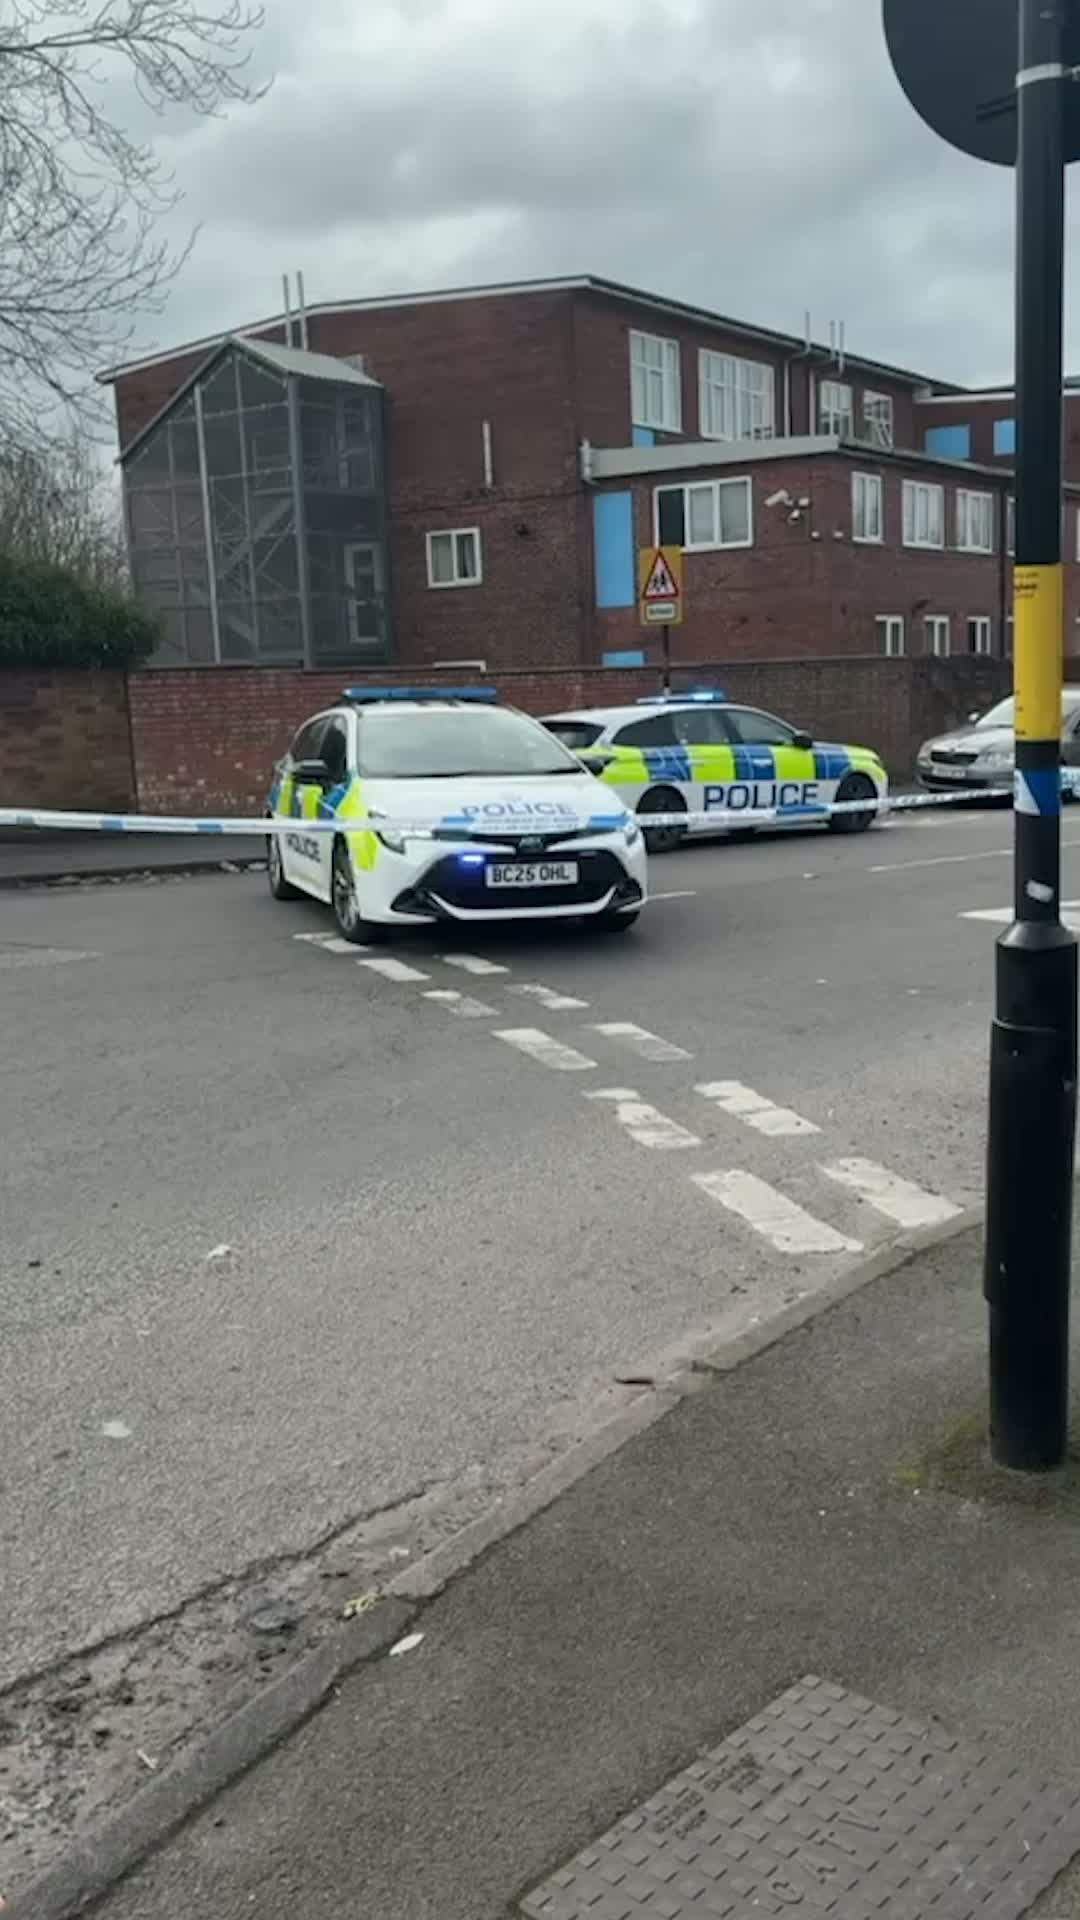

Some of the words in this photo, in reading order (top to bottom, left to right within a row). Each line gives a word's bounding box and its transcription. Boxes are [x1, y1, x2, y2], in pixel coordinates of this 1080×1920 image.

[704, 783, 819, 811] POLICE
[461, 802, 577, 817] POLICE
[493, 865, 535, 883] BC25
[539, 863, 570, 880] OHL
